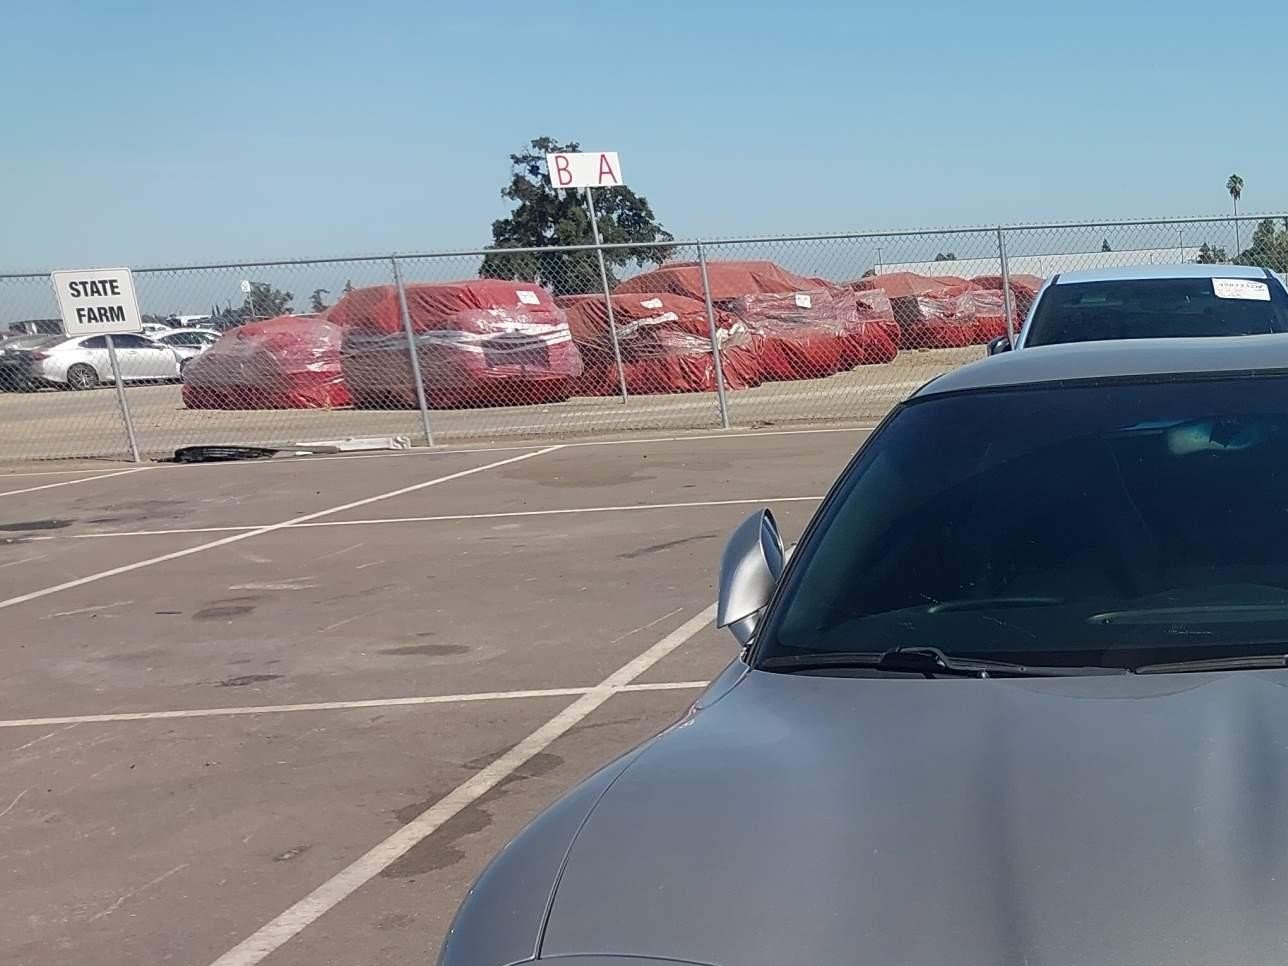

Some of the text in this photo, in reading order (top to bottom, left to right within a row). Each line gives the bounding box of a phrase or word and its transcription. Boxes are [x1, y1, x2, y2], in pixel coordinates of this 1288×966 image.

[554, 153, 619, 186] B A
[68, 279, 121, 298] STATE
[76, 305, 126, 324] FARM
